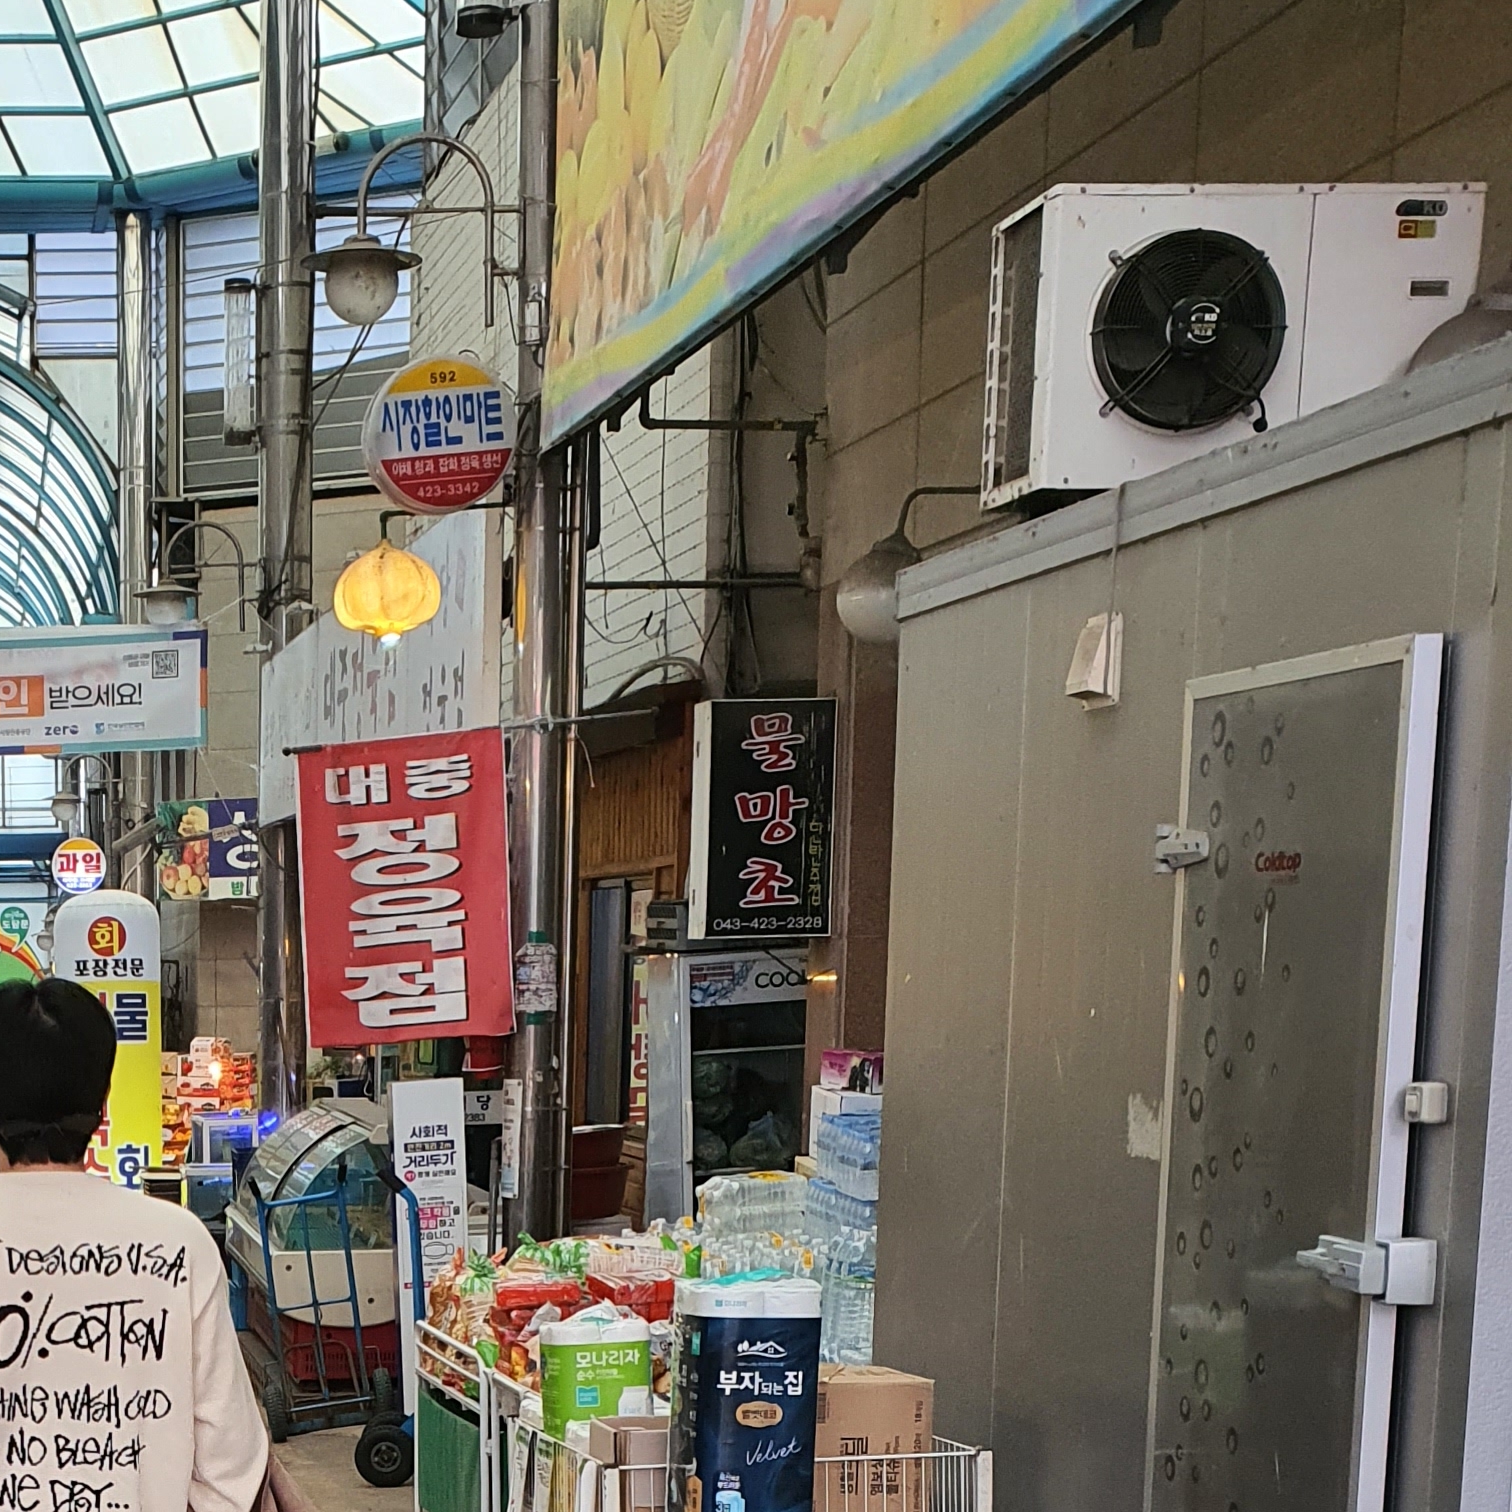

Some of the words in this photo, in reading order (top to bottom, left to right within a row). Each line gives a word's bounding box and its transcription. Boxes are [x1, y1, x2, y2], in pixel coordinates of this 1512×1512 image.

[430, 370, 457, 384] 592
[381, 390, 505, 452] 시장할인마트
[417, 482, 480, 498] 423-3342
[49, 682, 143, 710] 받으세요!
[324, 754, 473, 806] 대중
[734, 711, 810, 909] 물망초
[57, 852, 102, 874] 과일
[334, 811, 470, 1030] 정육점
[713, 916, 823, 931] 043-423-2328
[74, 958, 145, 978] 포장전문
[409, 1124, 449, 1140] 사회적
[576, 1348, 640, 1369] 모나리자
[6, 1427, 47, 1467] NO
[746, 1435, 802, 1466] Velvet
